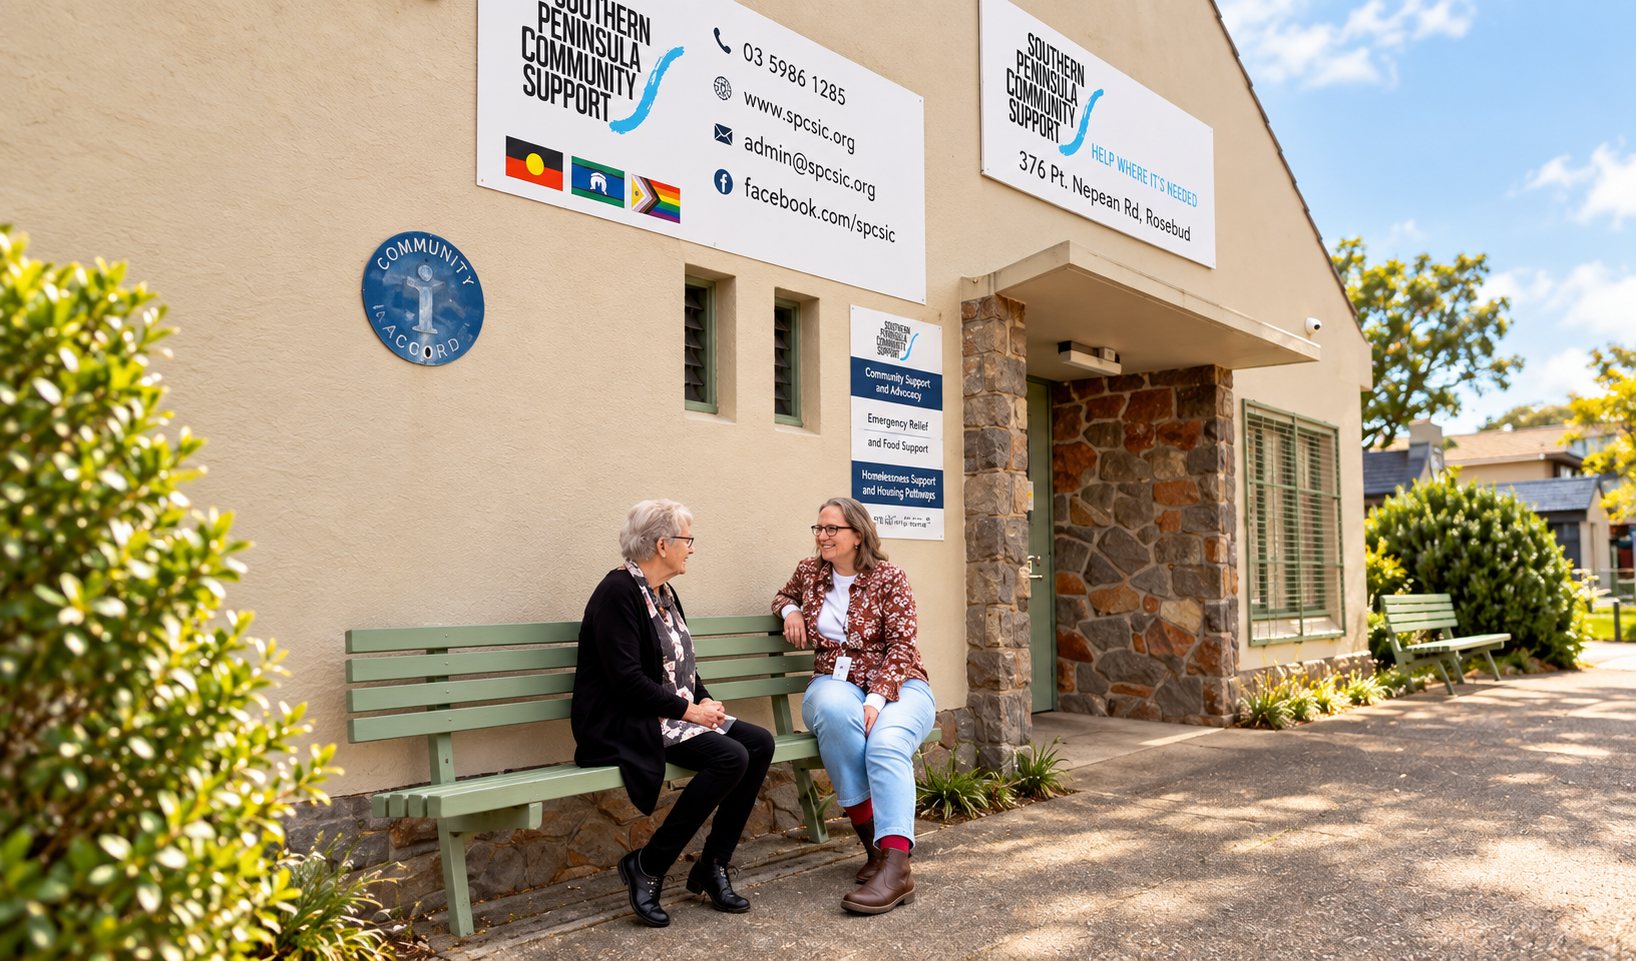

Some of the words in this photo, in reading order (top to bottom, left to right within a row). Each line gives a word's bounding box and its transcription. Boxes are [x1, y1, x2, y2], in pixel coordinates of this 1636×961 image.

[538, 1, 641, 73] PENINSULA
[555, 0, 650, 46] UTHERN
[522, 25, 636, 100] COMMUNITY
[743, 42, 763, 67] 03
[768, 54, 807, 88] 5986
[811, 74, 847, 106] 1285
[1016, 49, 1078, 107] PENINSULA
[1027, 32, 1085, 87] SOUTHERN
[523, 63, 611, 122] SUPPORT
[1006, 67, 1075, 128] COMMUNITY
[1009, 98, 1060, 143] SUPPORT
[744, 91, 856, 155] www.spcsic.org
[744, 136, 876, 201] admin@spcsic.org
[1019, 150, 1046, 179] 376
[1050, 165, 1068, 190] Pt.
[1072, 174, 1120, 212] Nepean
[1124, 198, 1142, 225] Rd,
[1146, 207, 1191, 242] Rosebud
[1091, 143, 1114, 167] HELP
[1117, 156, 1148, 185] WHERE
[1150, 171, 1165, 193] IT'S
[1167, 179, 1198, 208] NEEDED
[744, 178, 896, 244] facebook.com/spcsic
[377, 237, 475, 286] COMMUNITY
[865, 367, 904, 385] Community
[905, 374, 931, 389] Support
[876, 384, 889, 394] and
[867, 413, 908, 431] Emergency
[909, 419, 928, 431] Relief
[868, 438, 881, 448] and
[883, 438, 900, 450] Food
[902, 440, 928, 454] Support
[862, 469, 909, 483] Homelessness
[911, 474, 936, 487] Support
[862, 485, 876, 495] and
[877, 485, 904, 500] Housing
